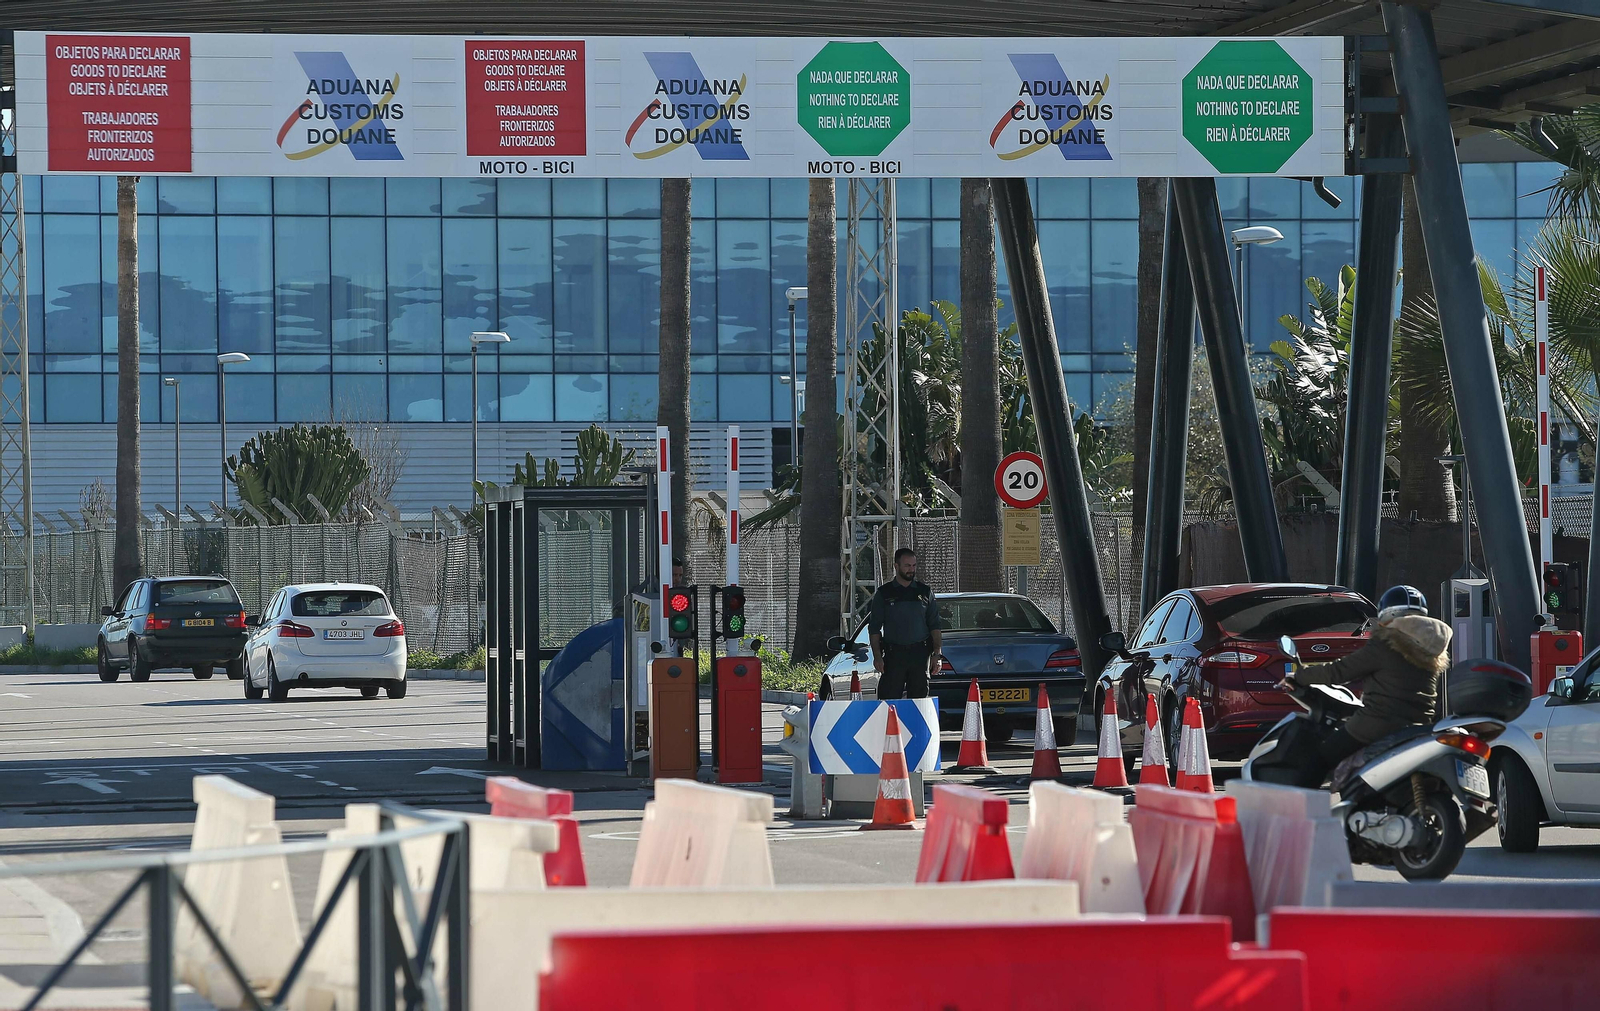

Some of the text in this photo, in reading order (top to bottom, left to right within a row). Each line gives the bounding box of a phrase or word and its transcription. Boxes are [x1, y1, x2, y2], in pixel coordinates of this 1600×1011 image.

[56, 46, 181, 60] OBJETOS PARA DECLARAR
[473, 49, 577, 60] OBJETOS PARA DECLARAR
[70, 64, 166, 78] GOODS TO DECLARE
[485, 65, 565, 76] GOODS TO DECLARE
[810, 71, 898, 84] NADA QUE DECLARAR
[69, 80, 168, 96] OBJETS À DÉCLARER
[306, 79, 396, 95] ADUANA
[484, 78, 567, 91] OBJETS À DÉCLARER
[655, 79, 742, 95] ADUANA
[1019, 80, 1105, 96] ADUANA
[1197, 75, 1299, 90] NADA QUE DECLARAR
[809, 94, 899, 106] NOTHING TO DECLARE
[299, 104, 404, 120] CUSTOMS
[495, 105, 559, 116] TRABAJADORES
[647, 104, 750, 120] CUSTOMS
[1011, 105, 1113, 120] CUSTOMS
[1196, 101, 1299, 116] NOTHING TO DECLARE
[82, 112, 158, 125] TRABAJADORES
[818, 113, 891, 128] RIEN À DÉCLARER
[500, 121, 554, 131] FRONTERIZOS
[1206, 124, 1290, 142] RIEN À DÉCLARER
[88, 130, 154, 143] FRONTERIZOS
[307, 128, 396, 144] DOUANE
[500, 136, 556, 146] AUTORIZADOS
[655, 128, 742, 144] DOUANE
[1020, 129, 1106, 145] DOUANE
[87, 148, 155, 161] AUTORIZADOS
[480, 161, 527, 174] MOTO
[543, 161, 574, 174] BICI
[808, 161, 855, 174] MOTO
[870, 161, 901, 174] BICI
[1008, 472, 1038, 489] 20
[990, 690, 1025, 699] 92221
[44, 764, 319, 778] STOP
